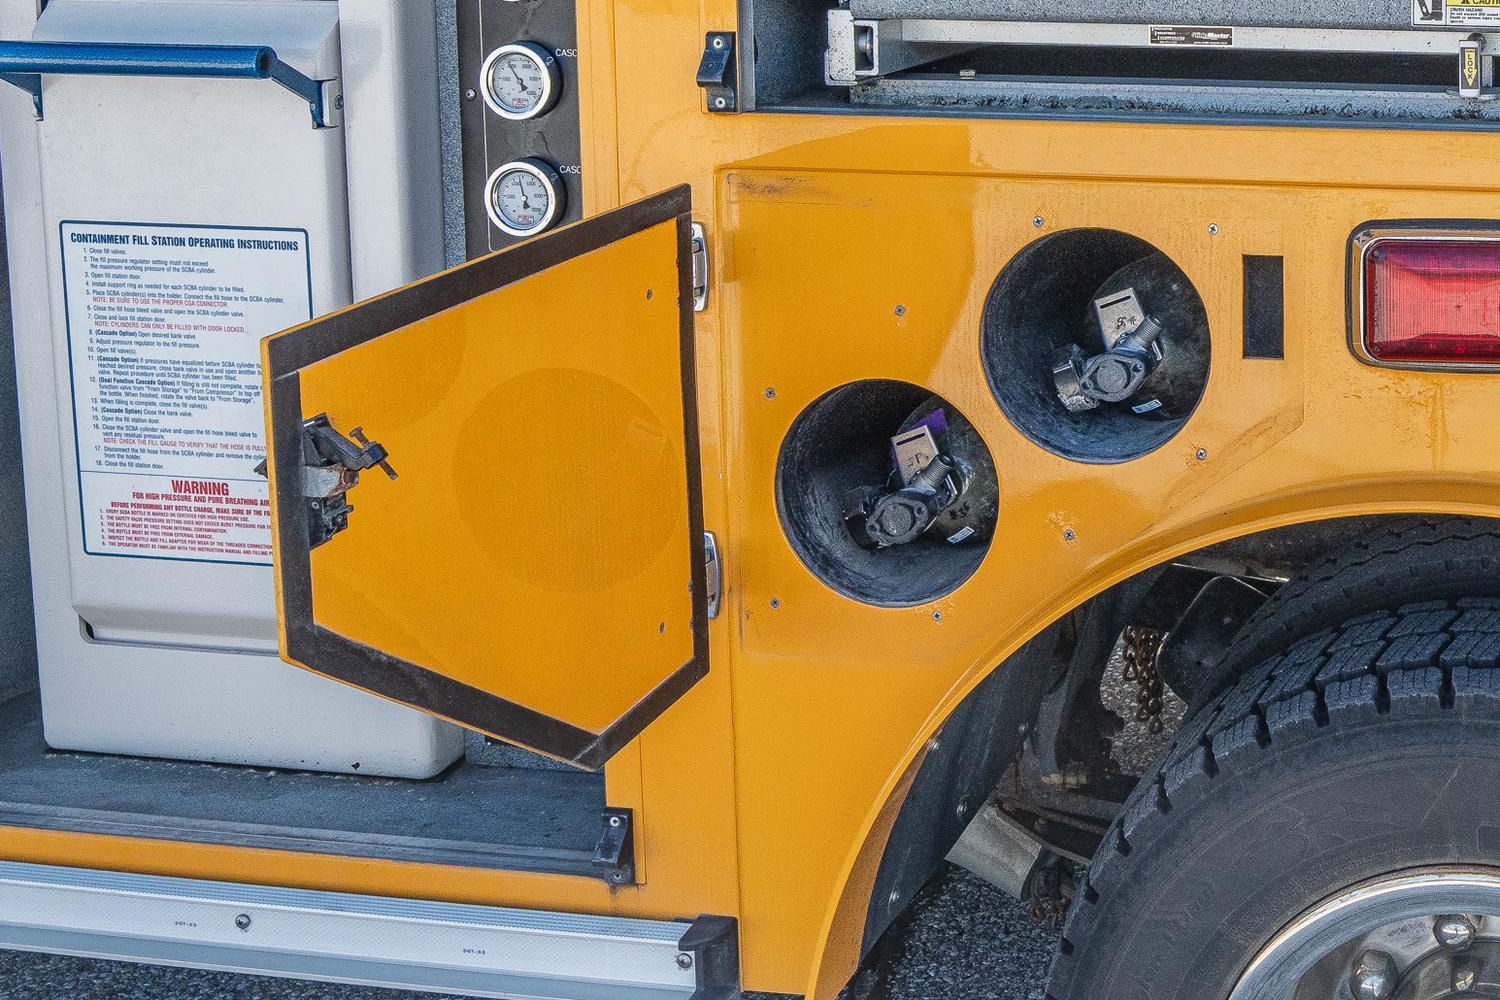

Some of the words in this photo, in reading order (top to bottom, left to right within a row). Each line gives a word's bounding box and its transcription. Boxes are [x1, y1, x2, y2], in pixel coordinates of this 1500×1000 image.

[70, 231, 129, 245] CONTAINMENT
[132, 234, 149, 245] FILL
[151, 234, 185, 247] STATION
[187, 236, 234, 249] OPERATING
[237, 238, 299, 251] INSTRUCTIONS
[128, 257, 150, 265] regulator
[162, 298, 183, 306] PROPER
[110, 320, 139, 328] CYLINDERS
[171, 479, 228, 496] WARNING
[132, 491, 144, 500] FOR
[144, 492, 159, 501] HIGH
[160, 492, 191, 502] PRESSURE
[193, 494, 206, 503] AND
[207, 495, 223, 504] PURE
[224, 496, 258, 506] BREATHING
[110, 501, 129, 509] BEFORE
[130, 502, 162, 511] PERFORMING
[174, 504, 192, 512] BOTTLE
[231, 507, 244, 515] SURE
[245, 508, 251, 516] OF
